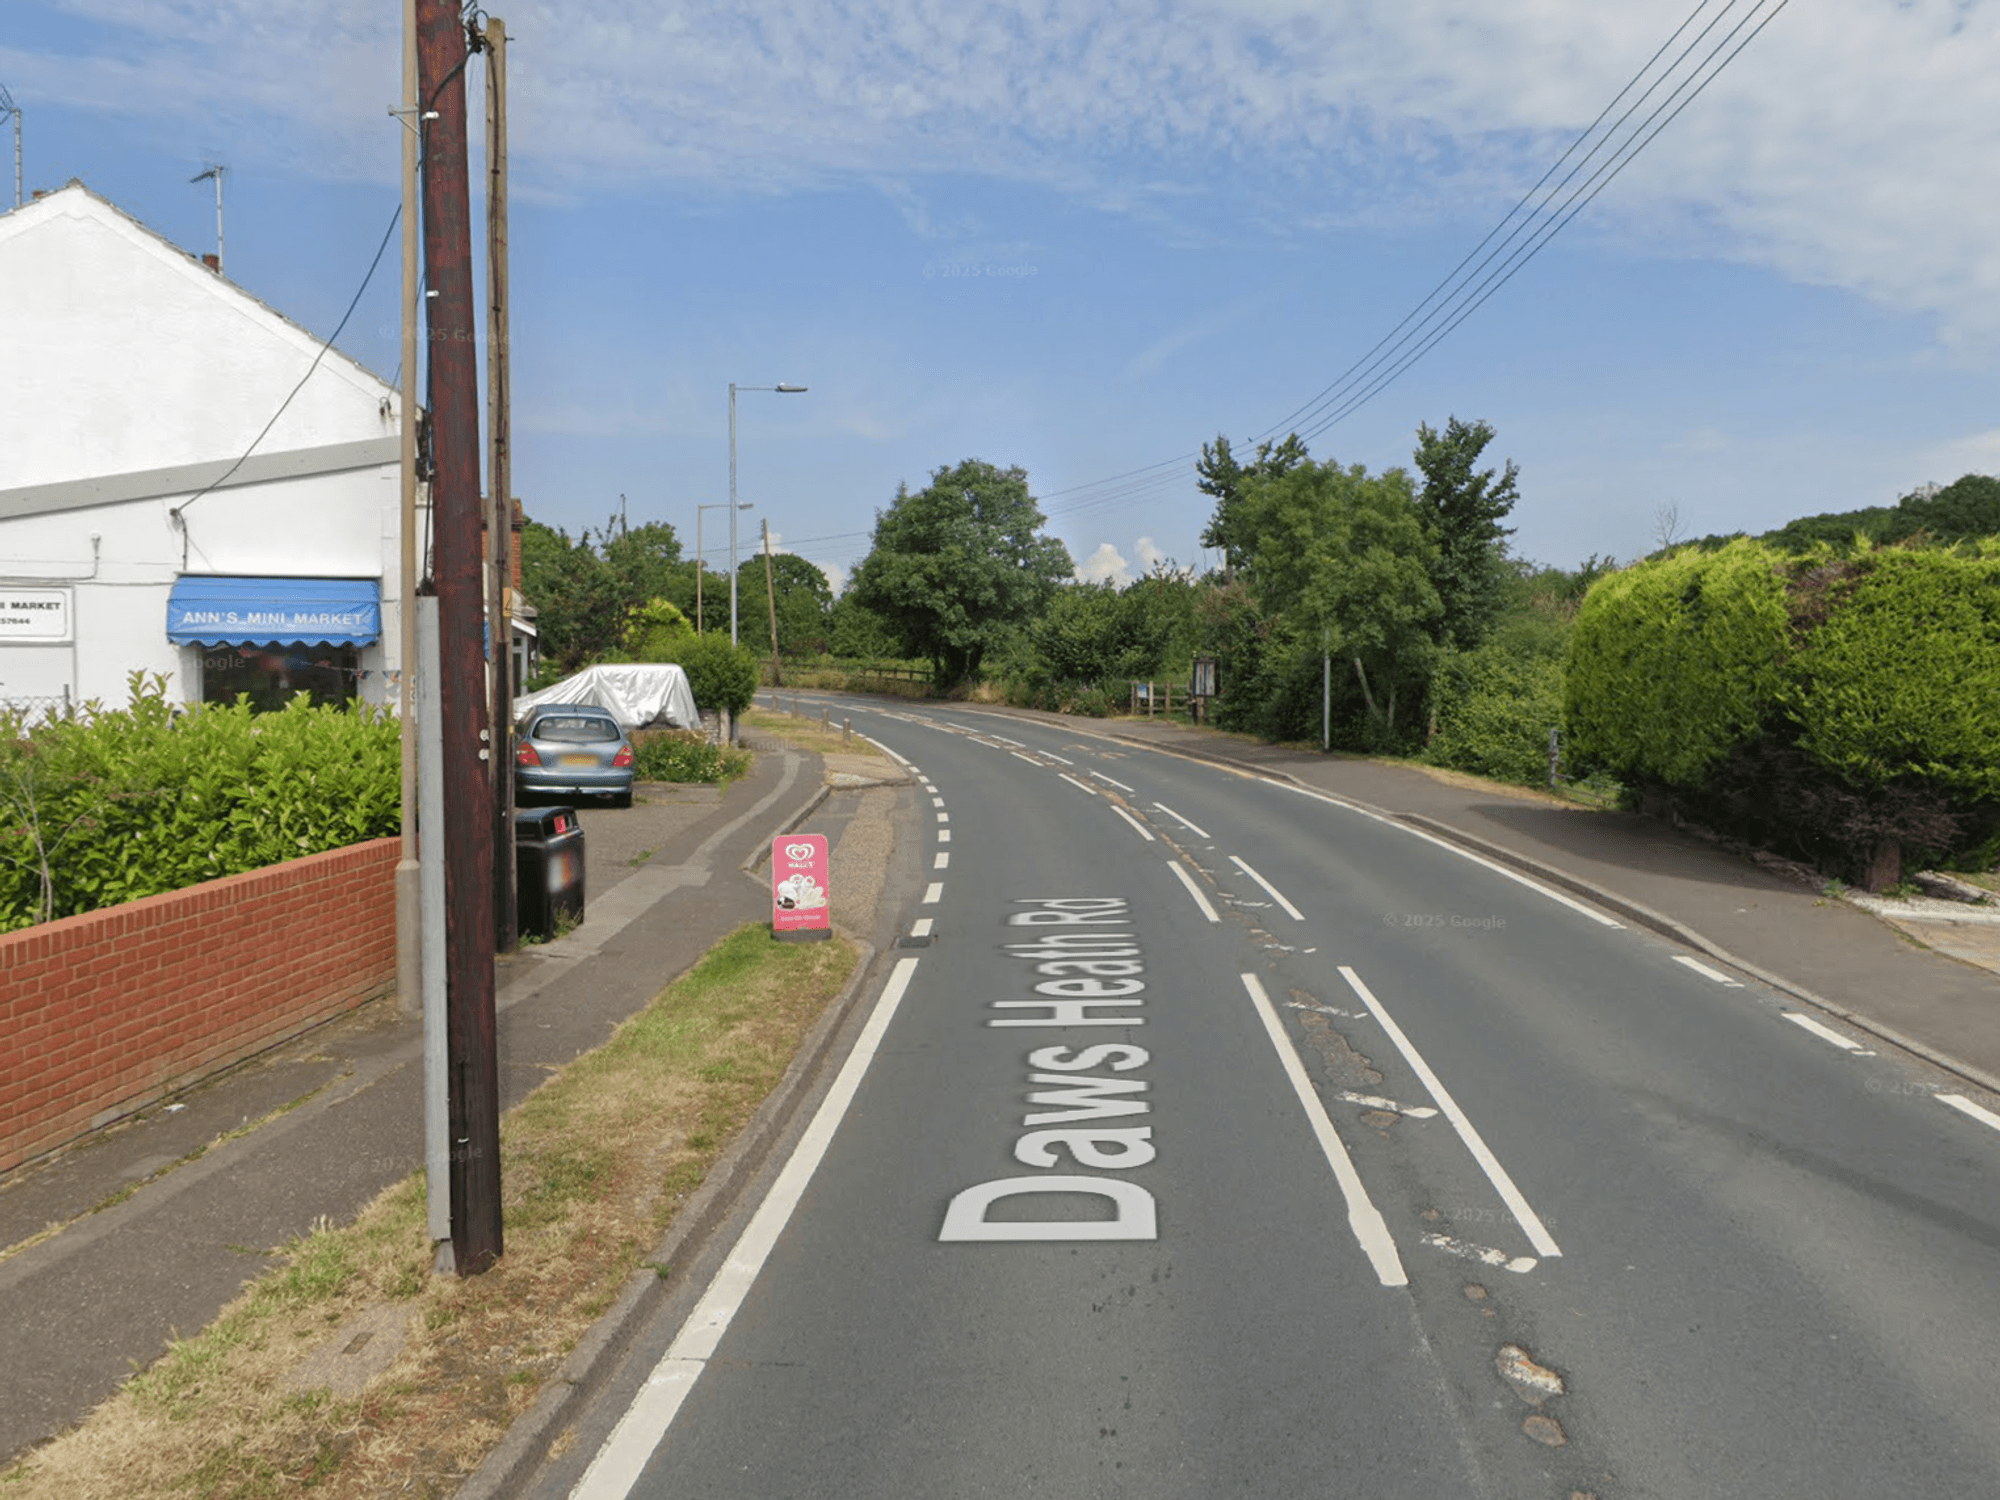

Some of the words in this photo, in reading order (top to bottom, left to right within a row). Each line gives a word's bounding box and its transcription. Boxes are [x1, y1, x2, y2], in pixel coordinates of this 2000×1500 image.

[11, 602, 61, 610] MARKET
[182, 610, 240, 625] ANN'S
[246, 611, 286, 626] MINI
[293, 612, 363, 626] MARKET
